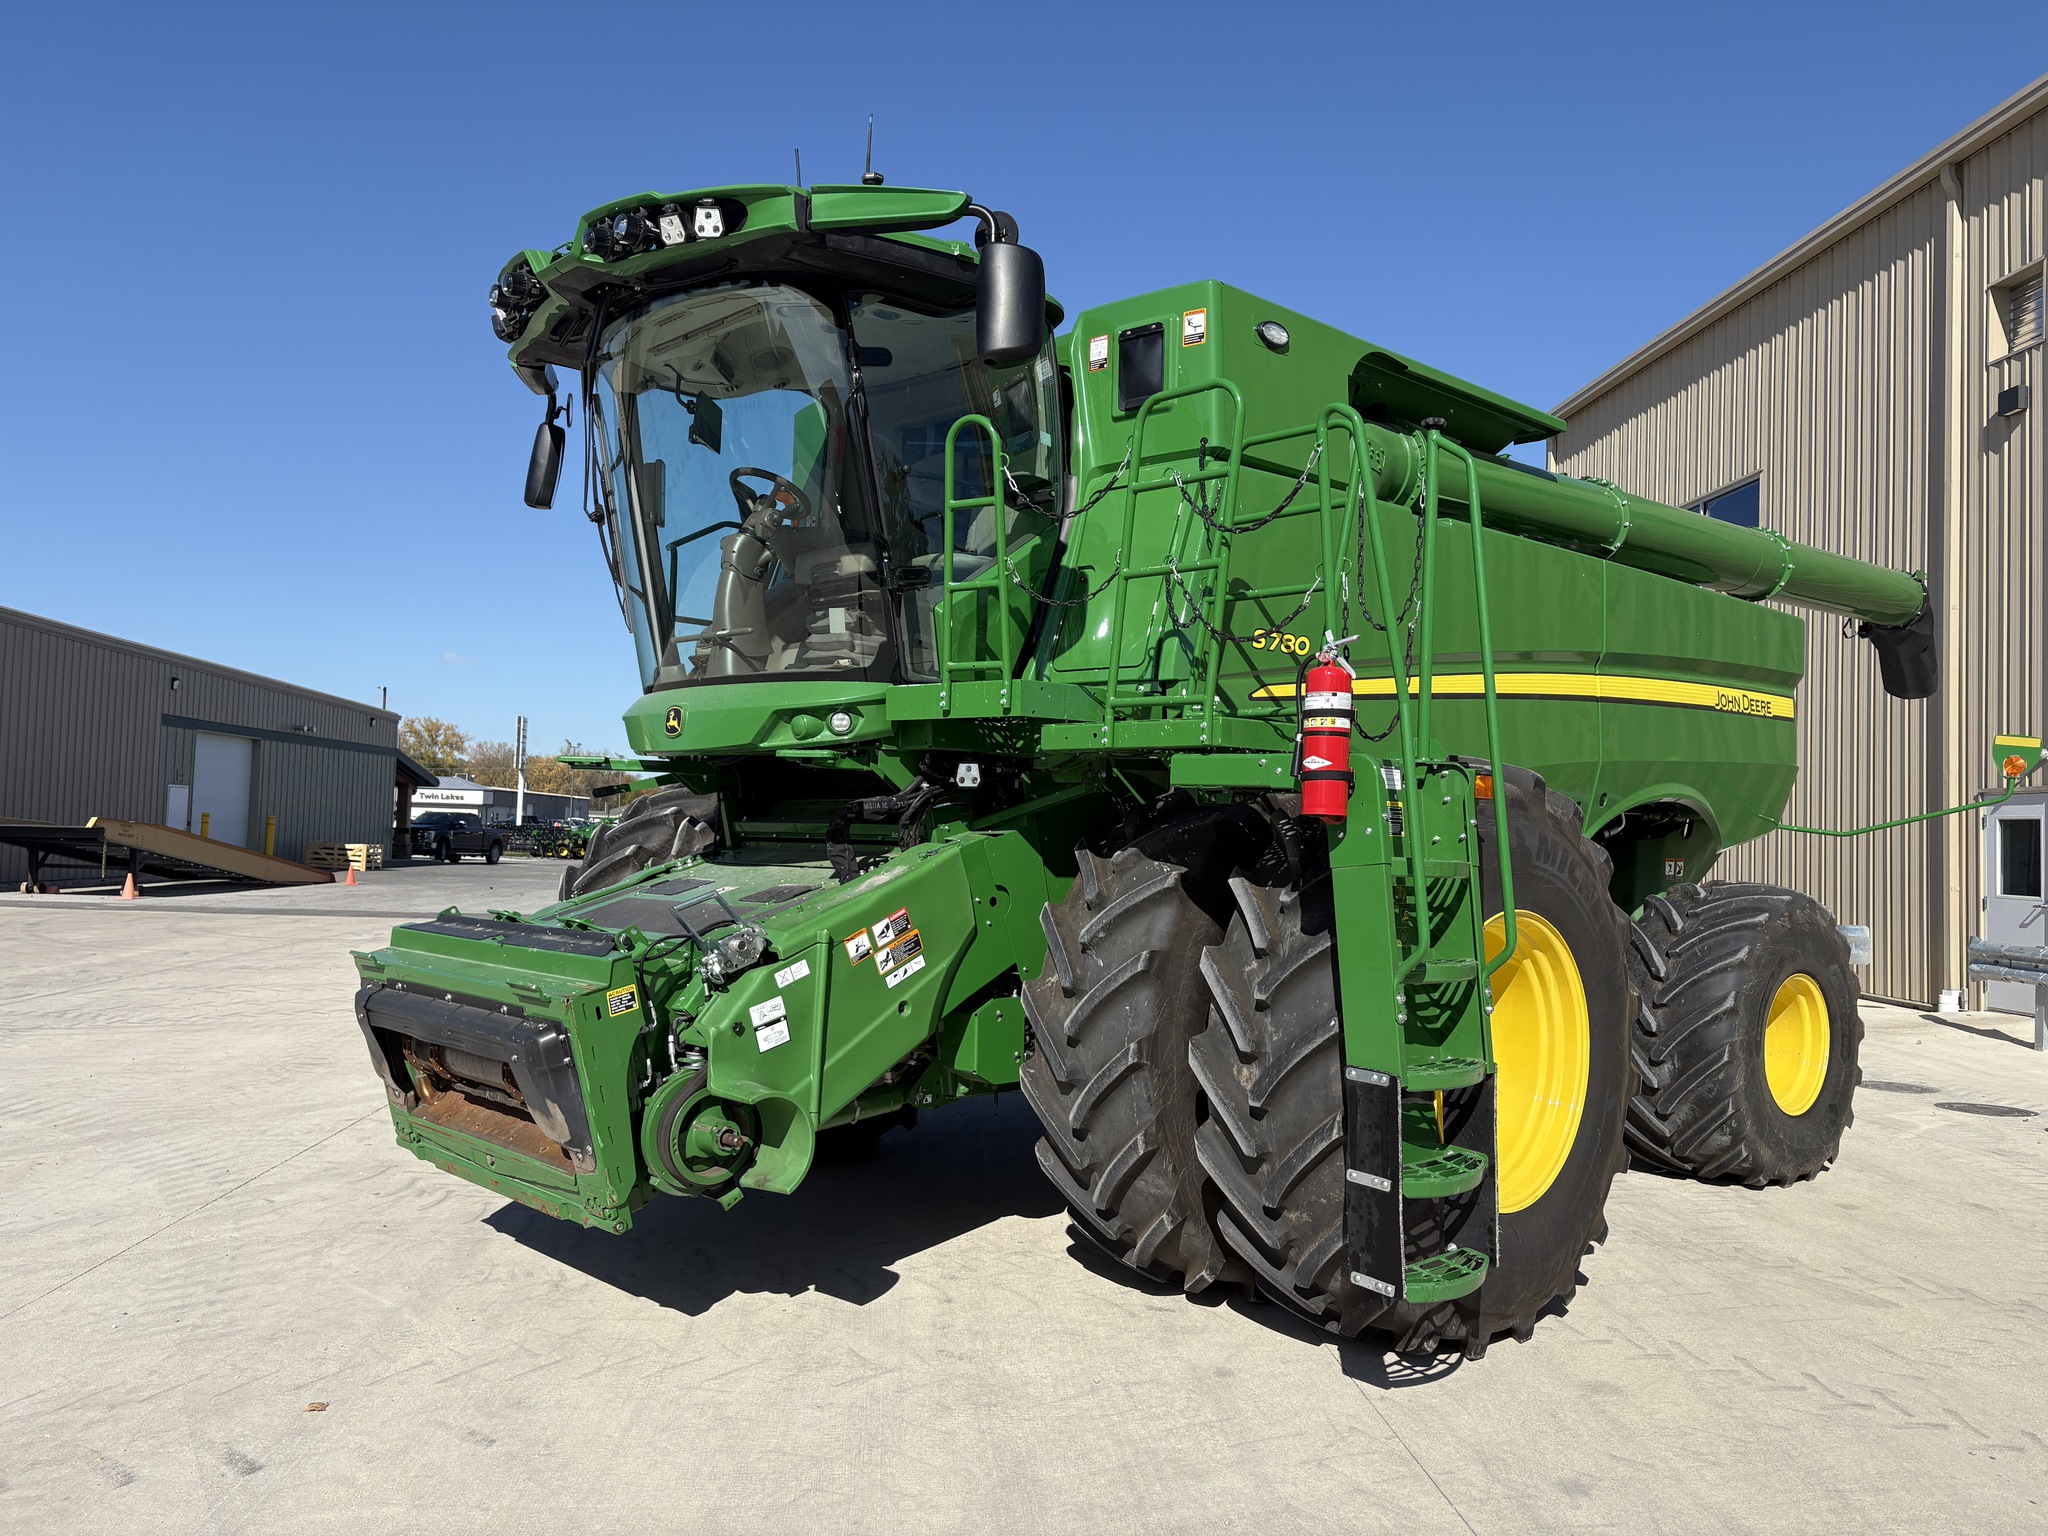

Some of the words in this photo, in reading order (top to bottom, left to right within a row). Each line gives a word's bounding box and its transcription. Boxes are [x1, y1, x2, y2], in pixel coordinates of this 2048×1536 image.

[1252, 628, 1310, 656] S780
[1715, 690, 1740, 711] JOHN
[1742, 694, 1772, 715] DEERE
[419, 792, 439, 800] Twin
